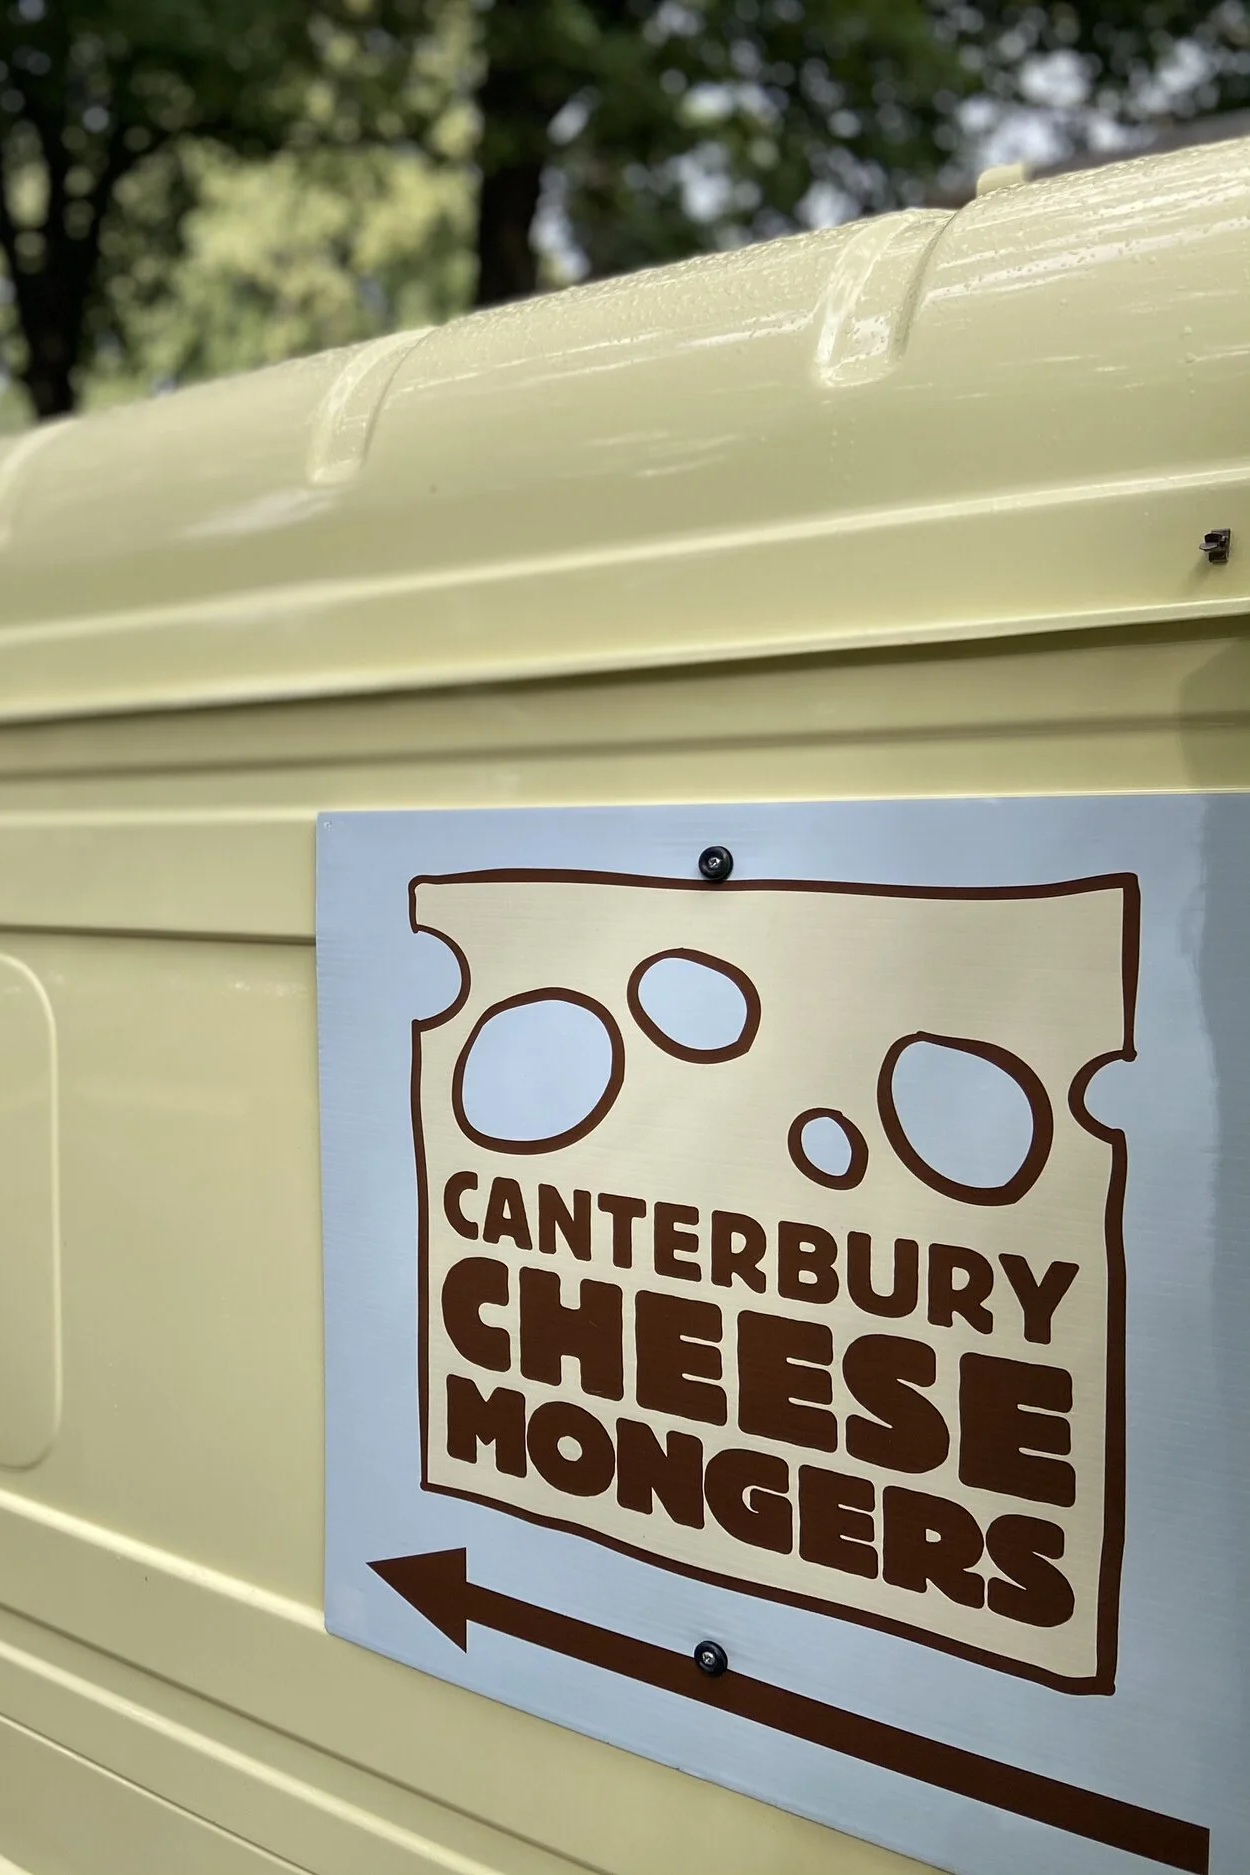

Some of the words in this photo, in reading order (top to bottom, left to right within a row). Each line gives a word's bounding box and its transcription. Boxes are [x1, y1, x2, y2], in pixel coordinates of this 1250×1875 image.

[441, 1256, 1077, 1508] CHEESE
[443, 1171, 1080, 1346] CANTERBURY
[446, 1374, 1076, 1628] MONGERS
